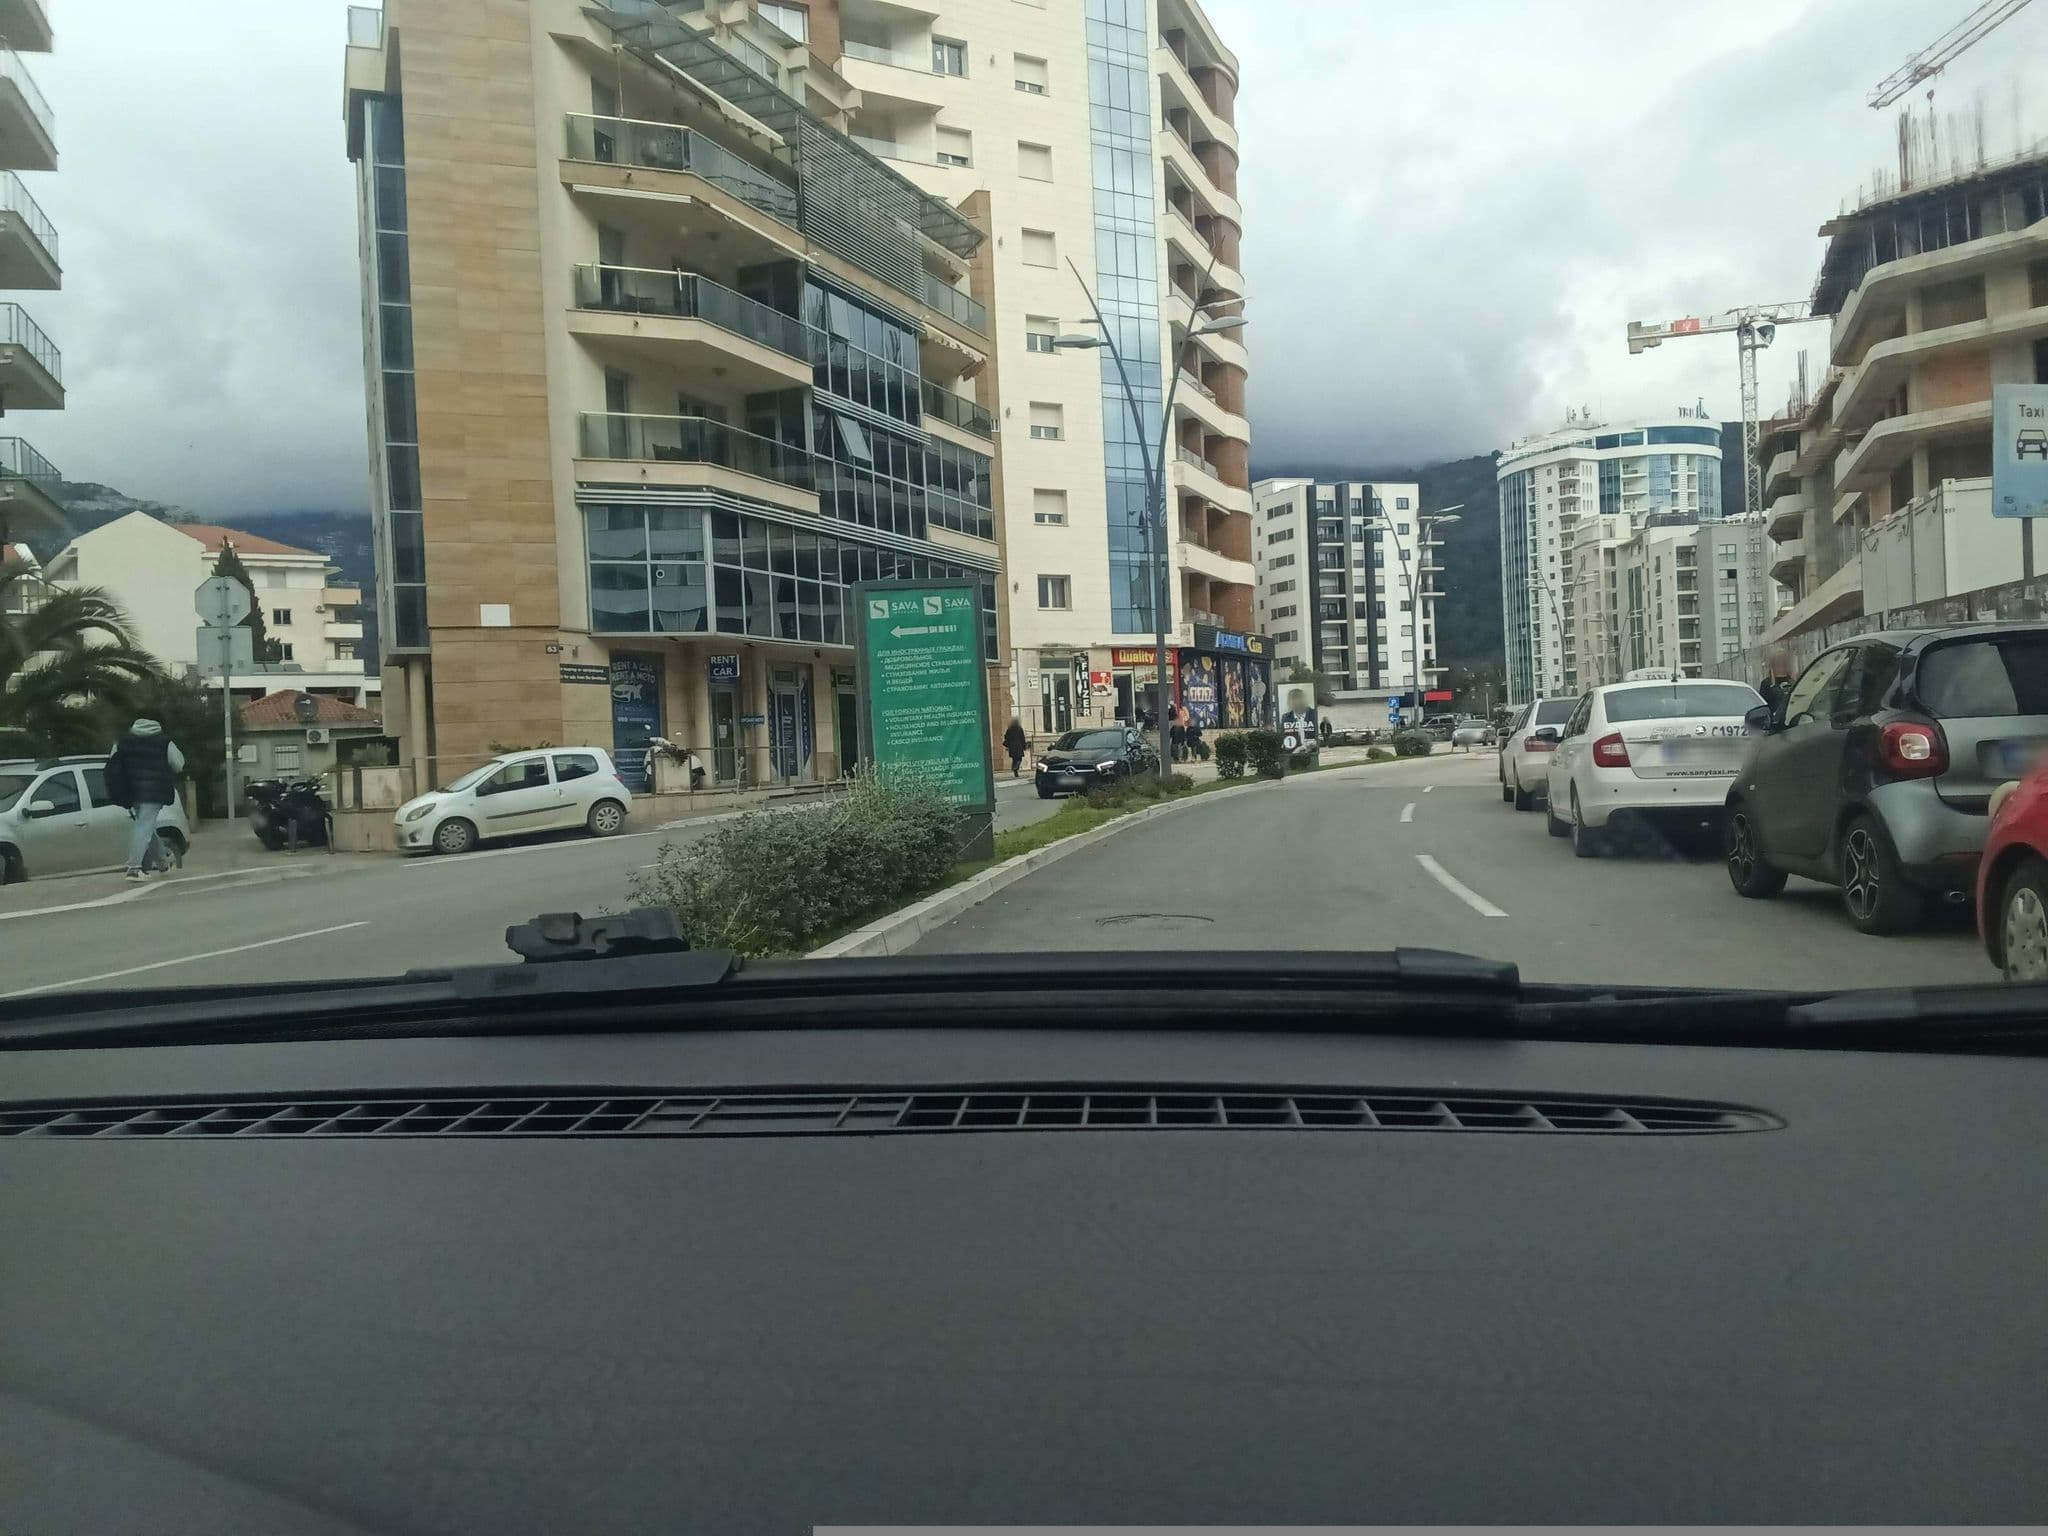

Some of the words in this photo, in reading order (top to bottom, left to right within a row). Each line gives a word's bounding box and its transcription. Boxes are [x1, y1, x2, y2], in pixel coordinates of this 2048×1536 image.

[2018, 404, 2045, 418] Taxi
[892, 601, 919, 611] SAVA
[944, 598, 971, 608] SAVA
[710, 655, 735, 664] RENT
[1119, 649, 1154, 664] Quality
[713, 667, 733, 676] CAR
[1081, 662, 1090, 717] FRIZER
